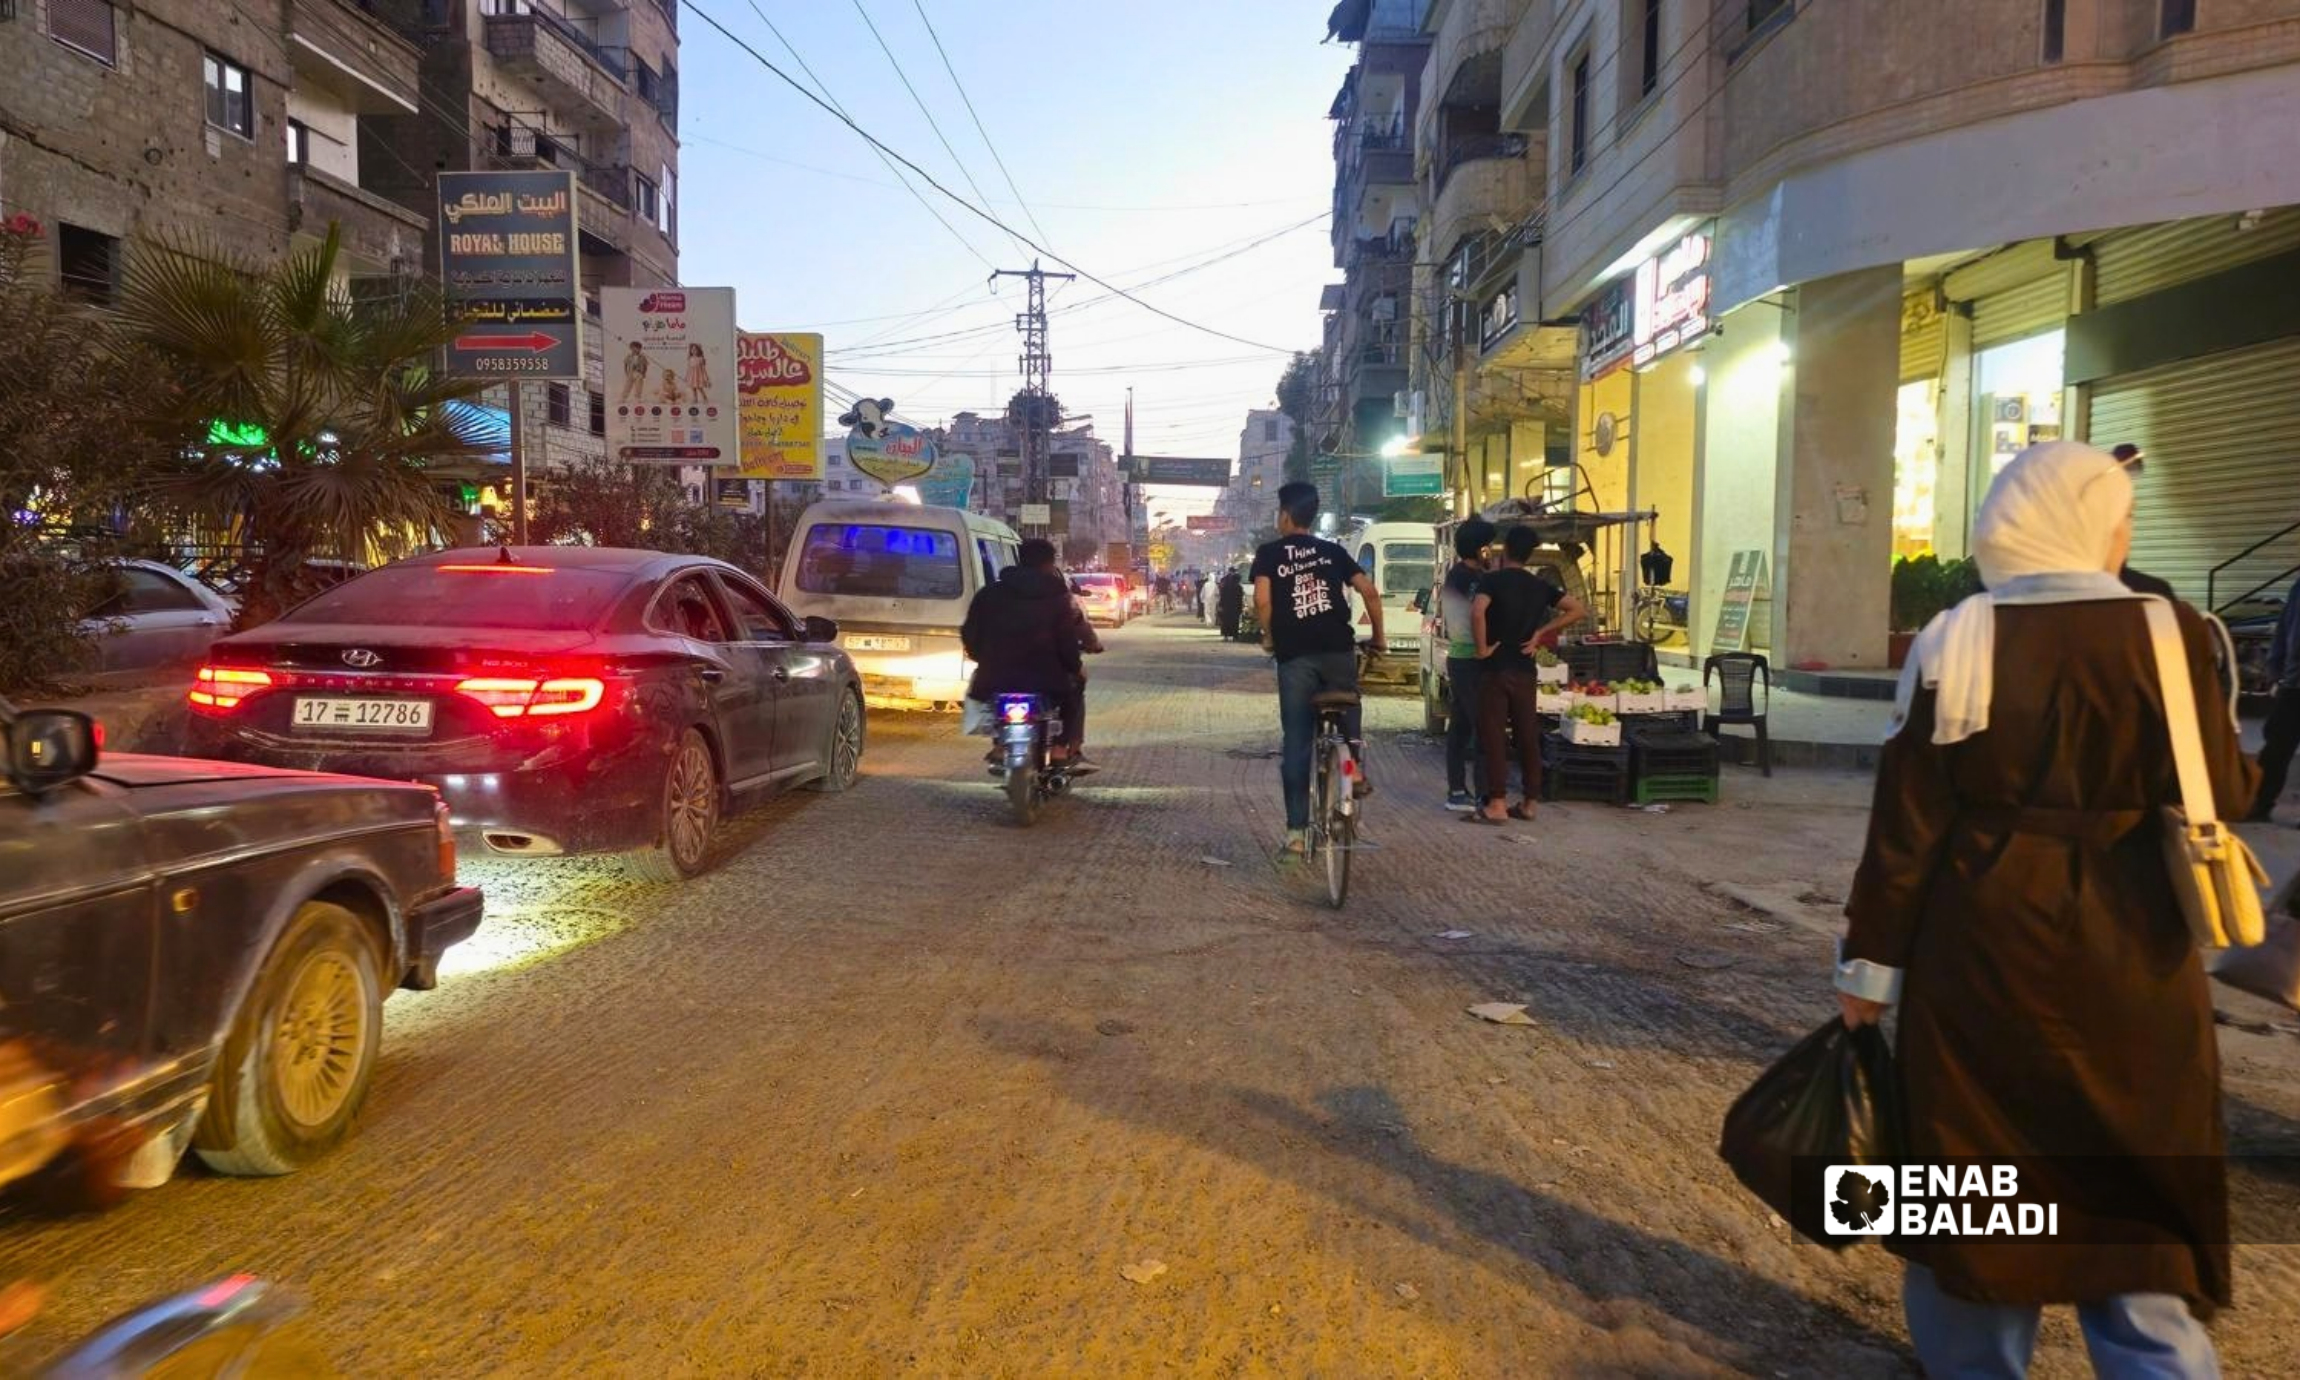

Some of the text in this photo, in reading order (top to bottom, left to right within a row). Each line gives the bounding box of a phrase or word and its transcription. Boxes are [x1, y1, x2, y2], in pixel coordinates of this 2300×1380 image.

[444, 191, 566, 224] البيت الملكي
[450, 233, 565, 255] ROYAL HOUSE
[476, 357, 549, 371] 0958359558
[302, 701, 421, 725] 17 12786
